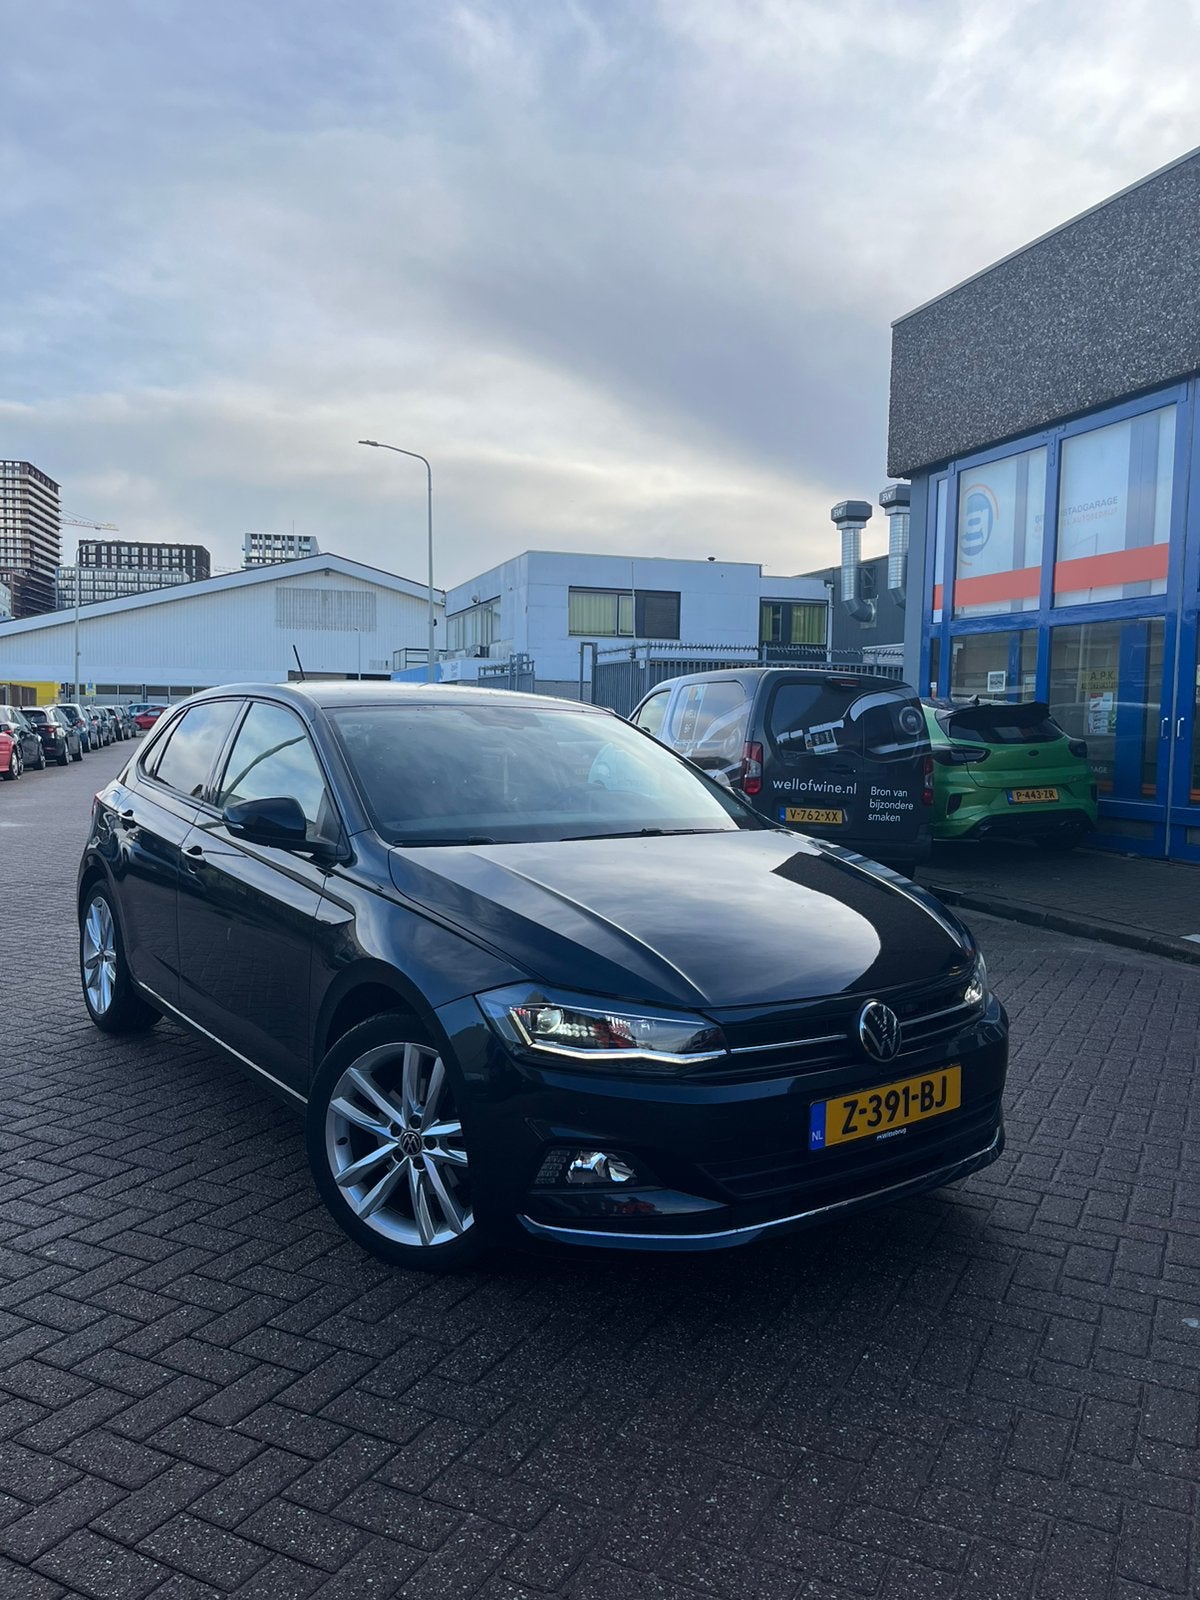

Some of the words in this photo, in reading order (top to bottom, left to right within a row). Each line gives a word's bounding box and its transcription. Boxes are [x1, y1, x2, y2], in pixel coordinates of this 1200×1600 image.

[773, 778, 857, 795] wellofwine.nl
[870, 786, 891, 797] Bron
[893, 788, 908, 797] van
[1016, 789, 1056, 800] P-443-ZR
[869, 799, 914, 811] bijzondere
[789, 809, 839, 822] V-762-XX
[867, 812, 901, 822] smaken
[841, 1075, 947, 1136] Z-391-BJ
[811, 1130, 824, 1142] NL
